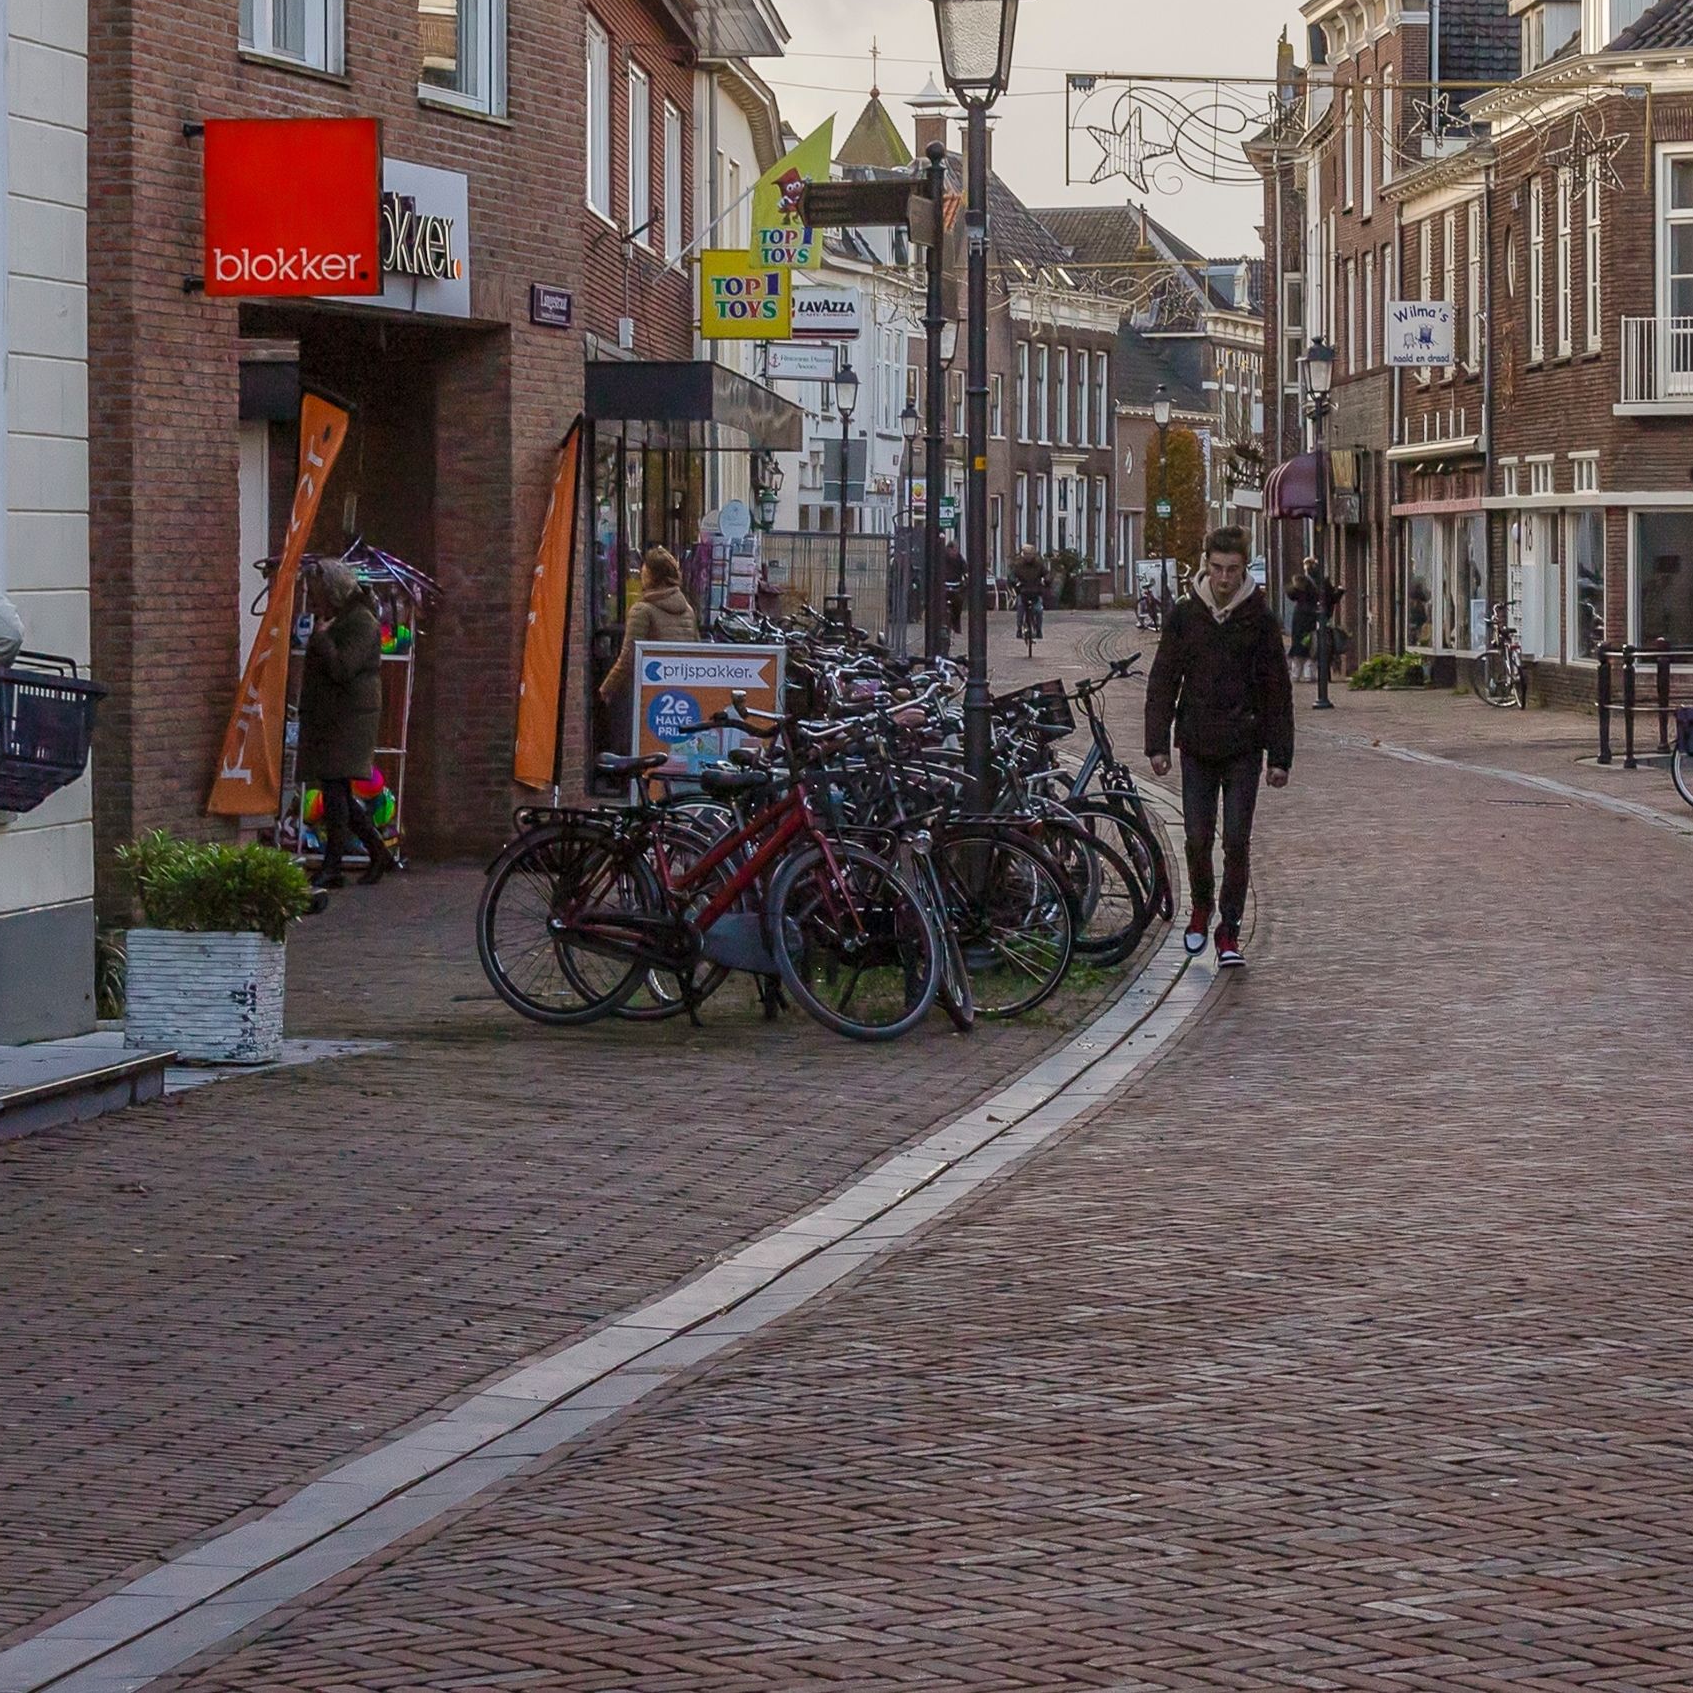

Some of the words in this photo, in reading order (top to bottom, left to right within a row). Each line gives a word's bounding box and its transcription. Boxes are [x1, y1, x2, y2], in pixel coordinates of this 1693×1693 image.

[760, 229, 797, 245] TOP
[802, 227, 812, 245] 1
[762, 248, 809, 264] TOYS
[712, 276, 761, 296] TOP
[764, 272, 780, 296] 1
[715, 300, 777, 319] TOYS
[798, 299, 855, 313] LAVAZZA
[1393, 305, 1449, 323] Wilma's
[1393, 353, 1413, 363] naald
[1416, 355, 1425, 363] en
[1428, 353, 1449, 363] draad
[660, 694, 690, 715] 2e
[656, 716, 693, 726] HALVE
